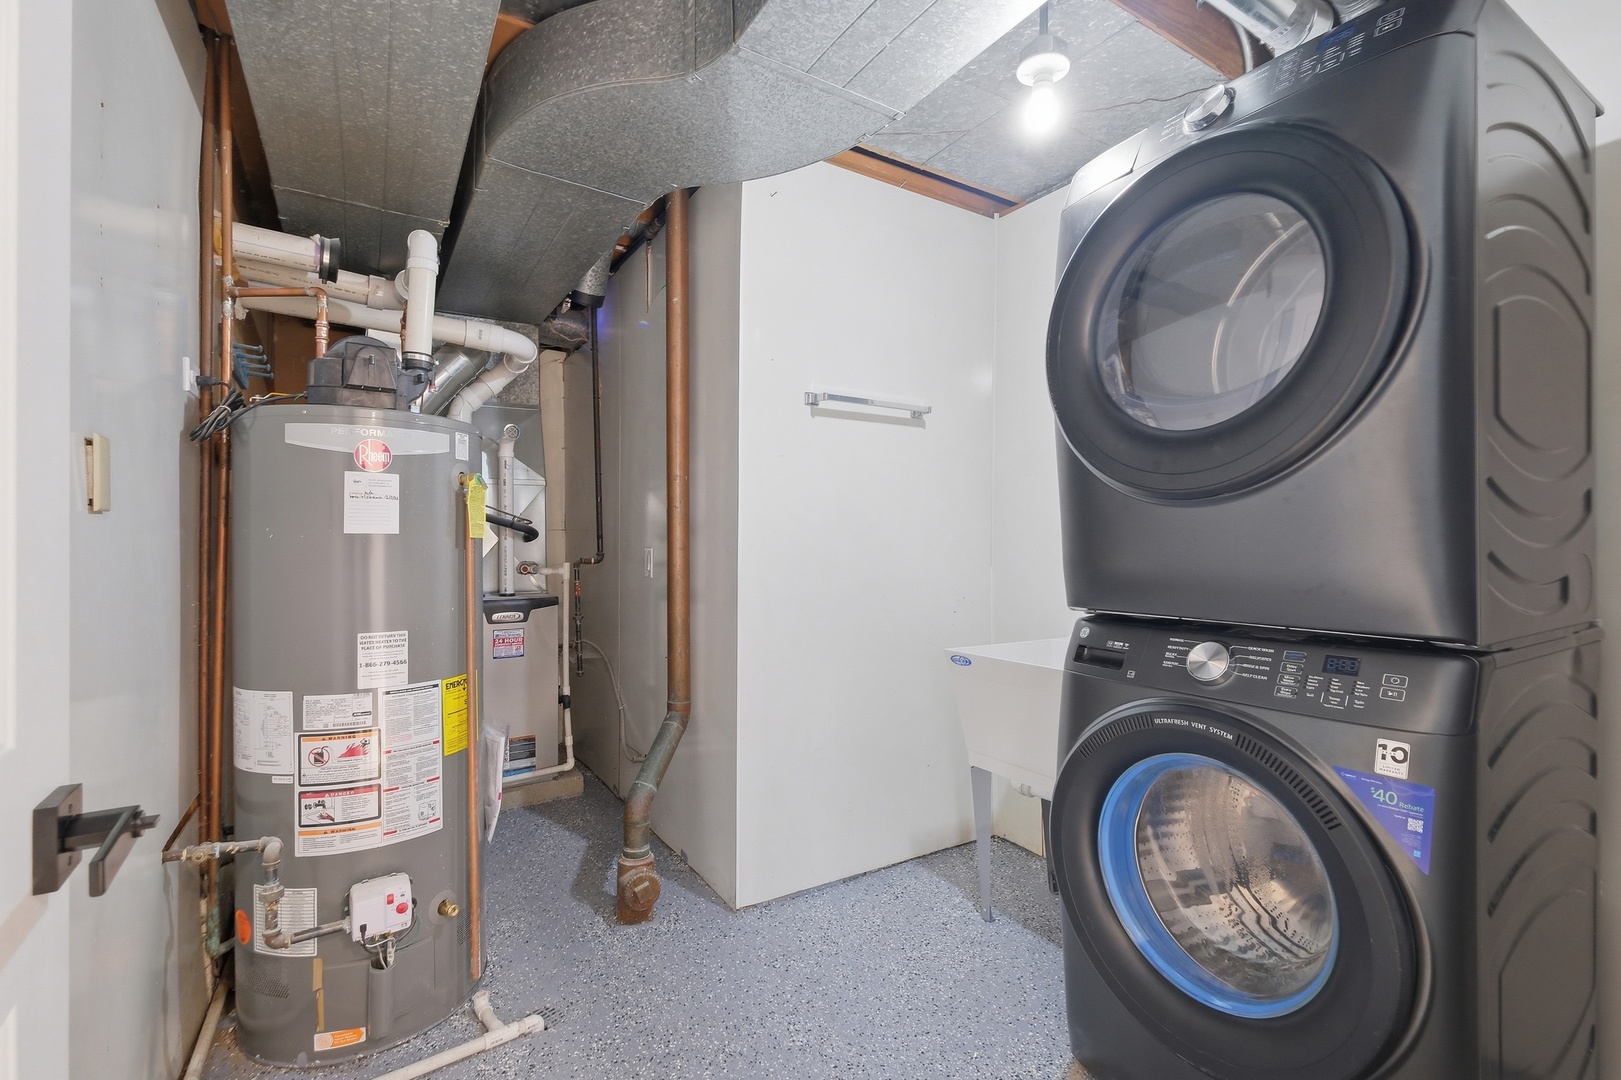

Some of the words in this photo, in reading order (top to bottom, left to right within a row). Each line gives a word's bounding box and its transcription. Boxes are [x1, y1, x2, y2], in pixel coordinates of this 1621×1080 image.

[358, 440, 390, 466] Rheem
[359, 659, 408, 668] 1-866-279-4566
[1154, 718, 1189, 726] ULTRAFRESH
[1191, 721, 1207, 730] VENT
[1209, 726, 1233, 740] SYSTEM
[1399, 802, 1424, 813] Rebate
